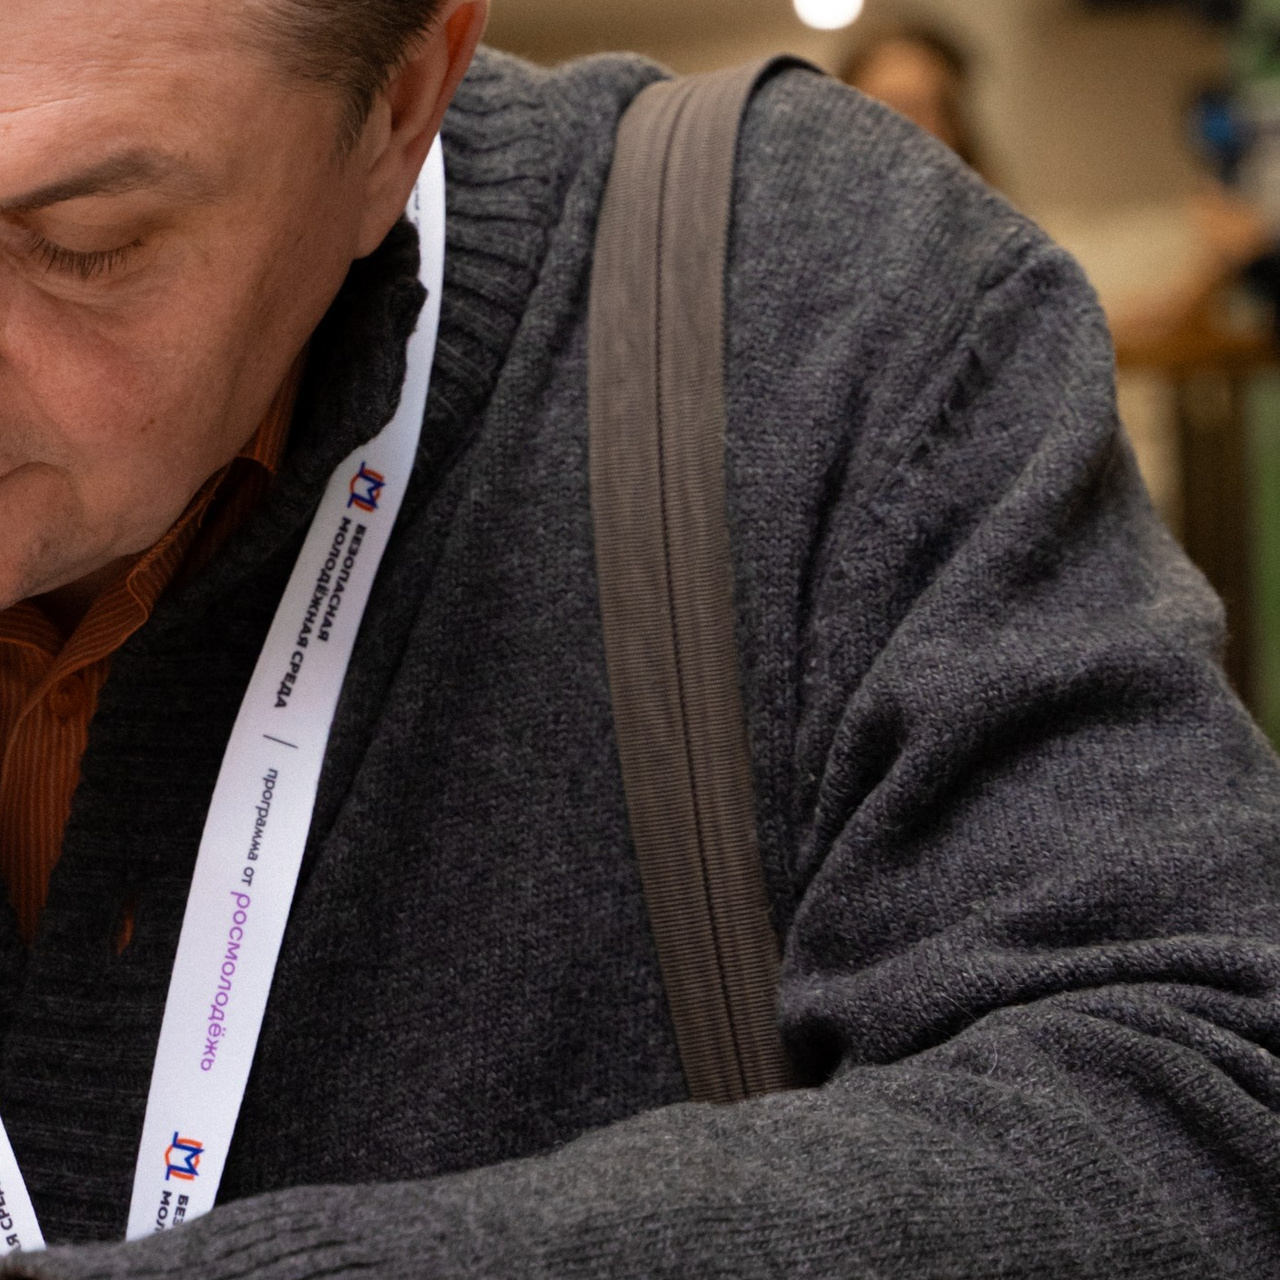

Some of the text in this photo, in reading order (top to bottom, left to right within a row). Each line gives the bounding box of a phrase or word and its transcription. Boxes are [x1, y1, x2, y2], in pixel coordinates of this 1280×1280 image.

[274, 516, 352, 709] МОЛОДЁЖНАЯ СРЕДА
[317, 523, 367, 643] БЕЗОПАСНАЯ
[200, 767, 279, 1072] программа от росмолодёжь
